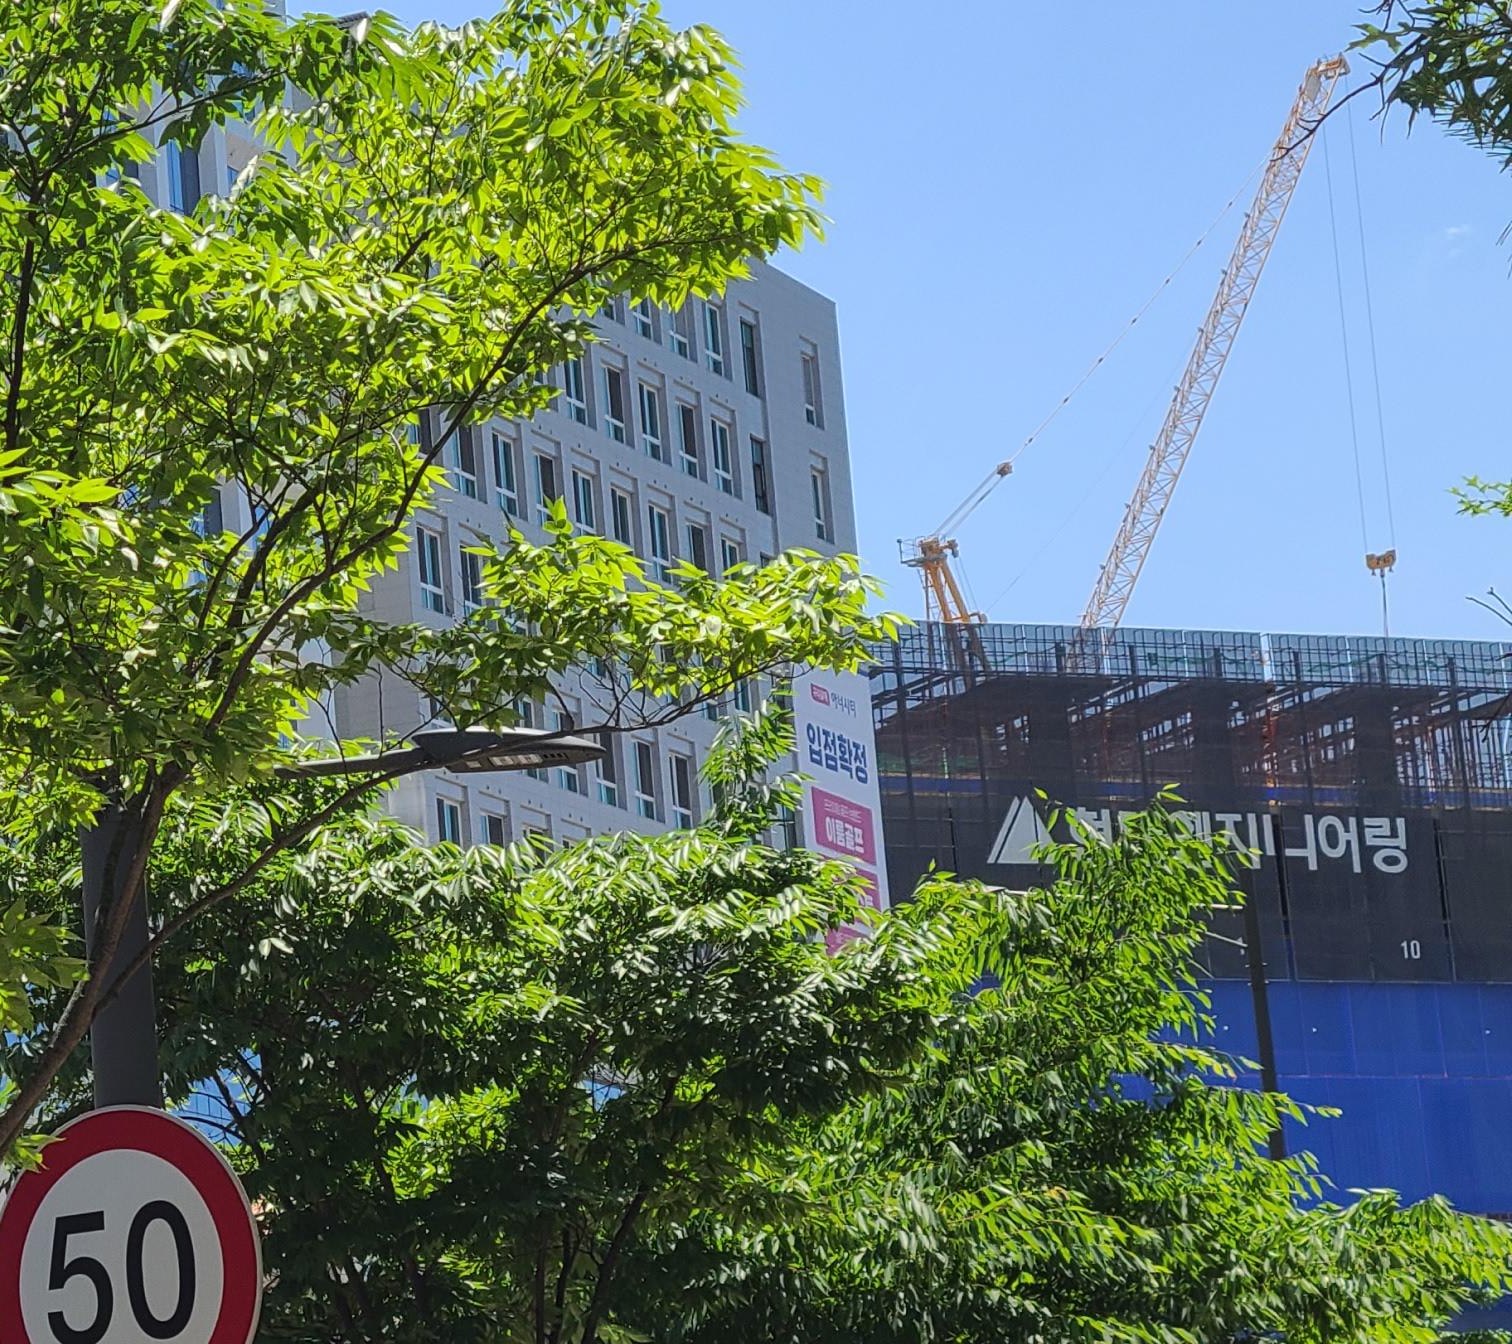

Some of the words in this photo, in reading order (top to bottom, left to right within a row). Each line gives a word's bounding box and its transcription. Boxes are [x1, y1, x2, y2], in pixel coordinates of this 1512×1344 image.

[806, 722, 868, 784] 입점확정
[1069, 806, 1408, 874] 현엔지니어링
[1400, 940, 1421, 959] 10
